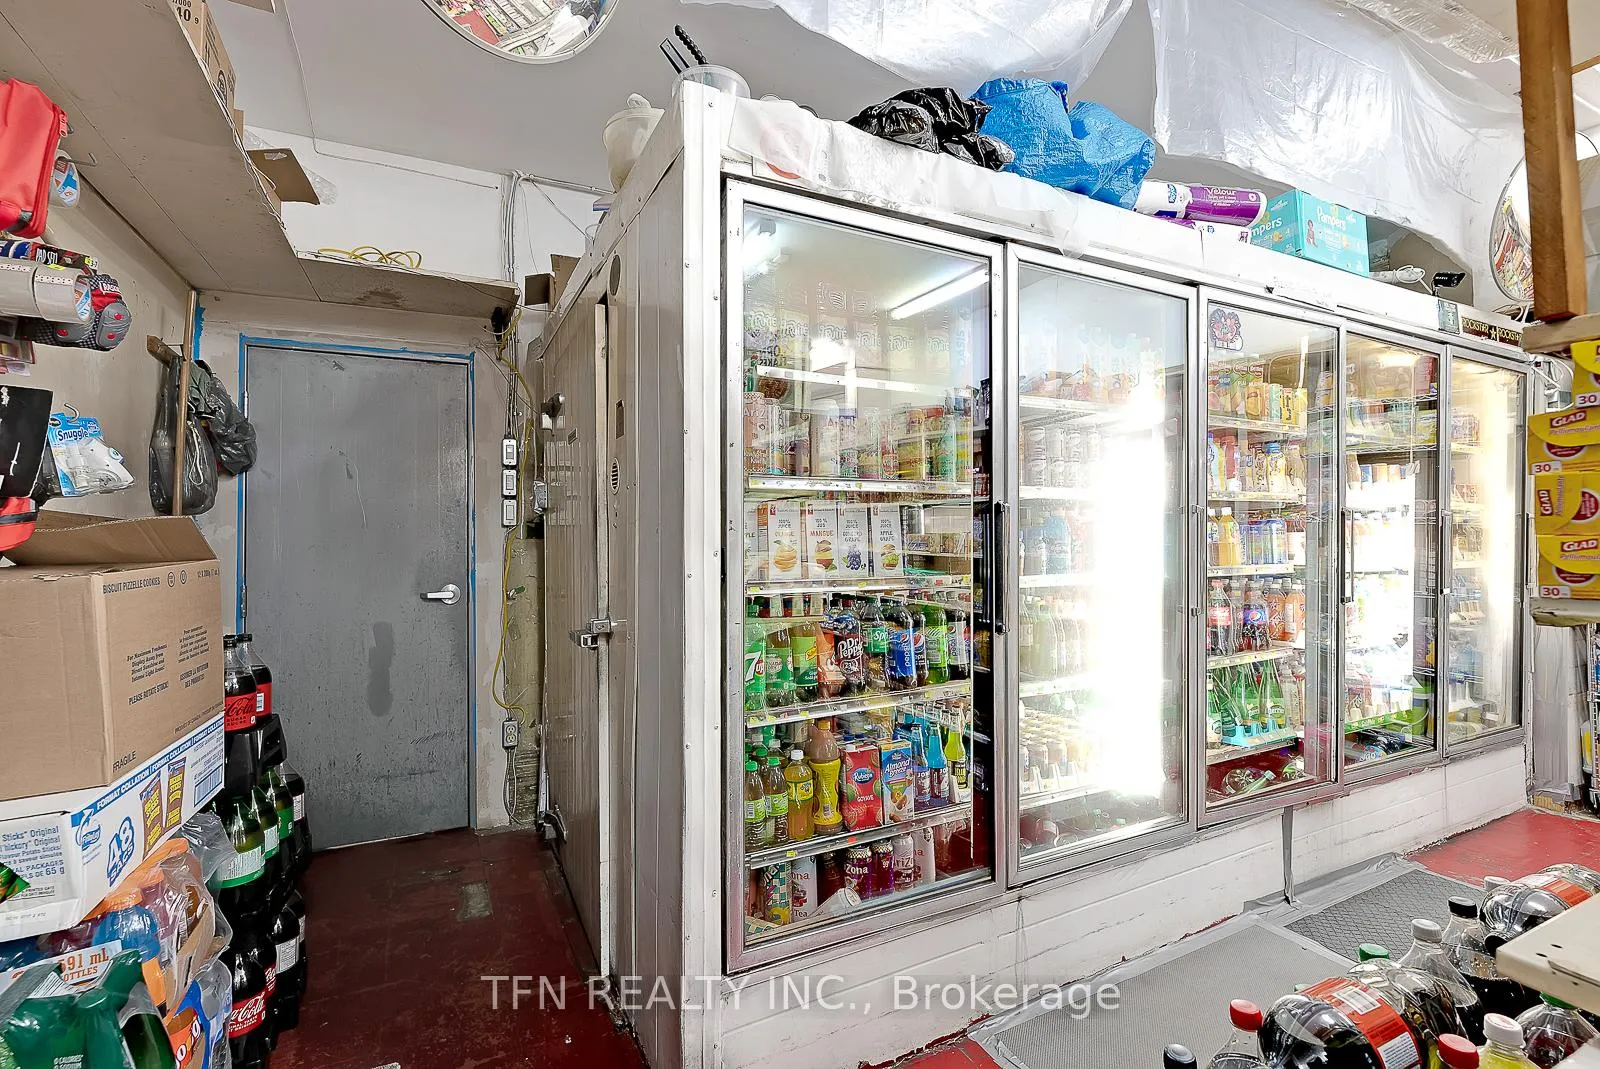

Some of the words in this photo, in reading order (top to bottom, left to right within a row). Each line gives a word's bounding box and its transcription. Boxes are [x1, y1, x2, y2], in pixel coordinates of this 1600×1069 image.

[1204, 187, 1237, 196] Velour
[1250, 217, 1282, 236] mpers
[1578, 395, 1597, 404] 30
[1551, 411, 1585, 427] GLAD
[57, 427, 89, 441] Snuggle
[1535, 464, 1551, 472] 30
[1539, 490, 1552, 515] GLAD
[1563, 539, 1597, 551] GLAD
[103, 582, 122, 594] BISCUIT
[123, 579, 143, 591] PIZZELLE
[143, 577, 161, 587] COOKIES
[1543, 587, 1559, 596] 30
[848, 637, 859, 648] Dr
[903, 642, 911, 667] pepsi
[112, 751, 137, 773] FRAGILE
[885, 759, 911, 774] Almond
[96, 789, 121, 810] FORMAT
[121, 768, 150, 793] COLLATION
[30, 826, 59, 837] Original
[34, 836, 60, 846] Original
[108, 816, 134, 870] 48
[26, 860, 64, 871] PACKAGES
[46, 866, 57, 875] 65
[60, 867, 65, 875] g
[90, 948, 110, 965] mL
[63, 966, 98, 982] OTTLES
